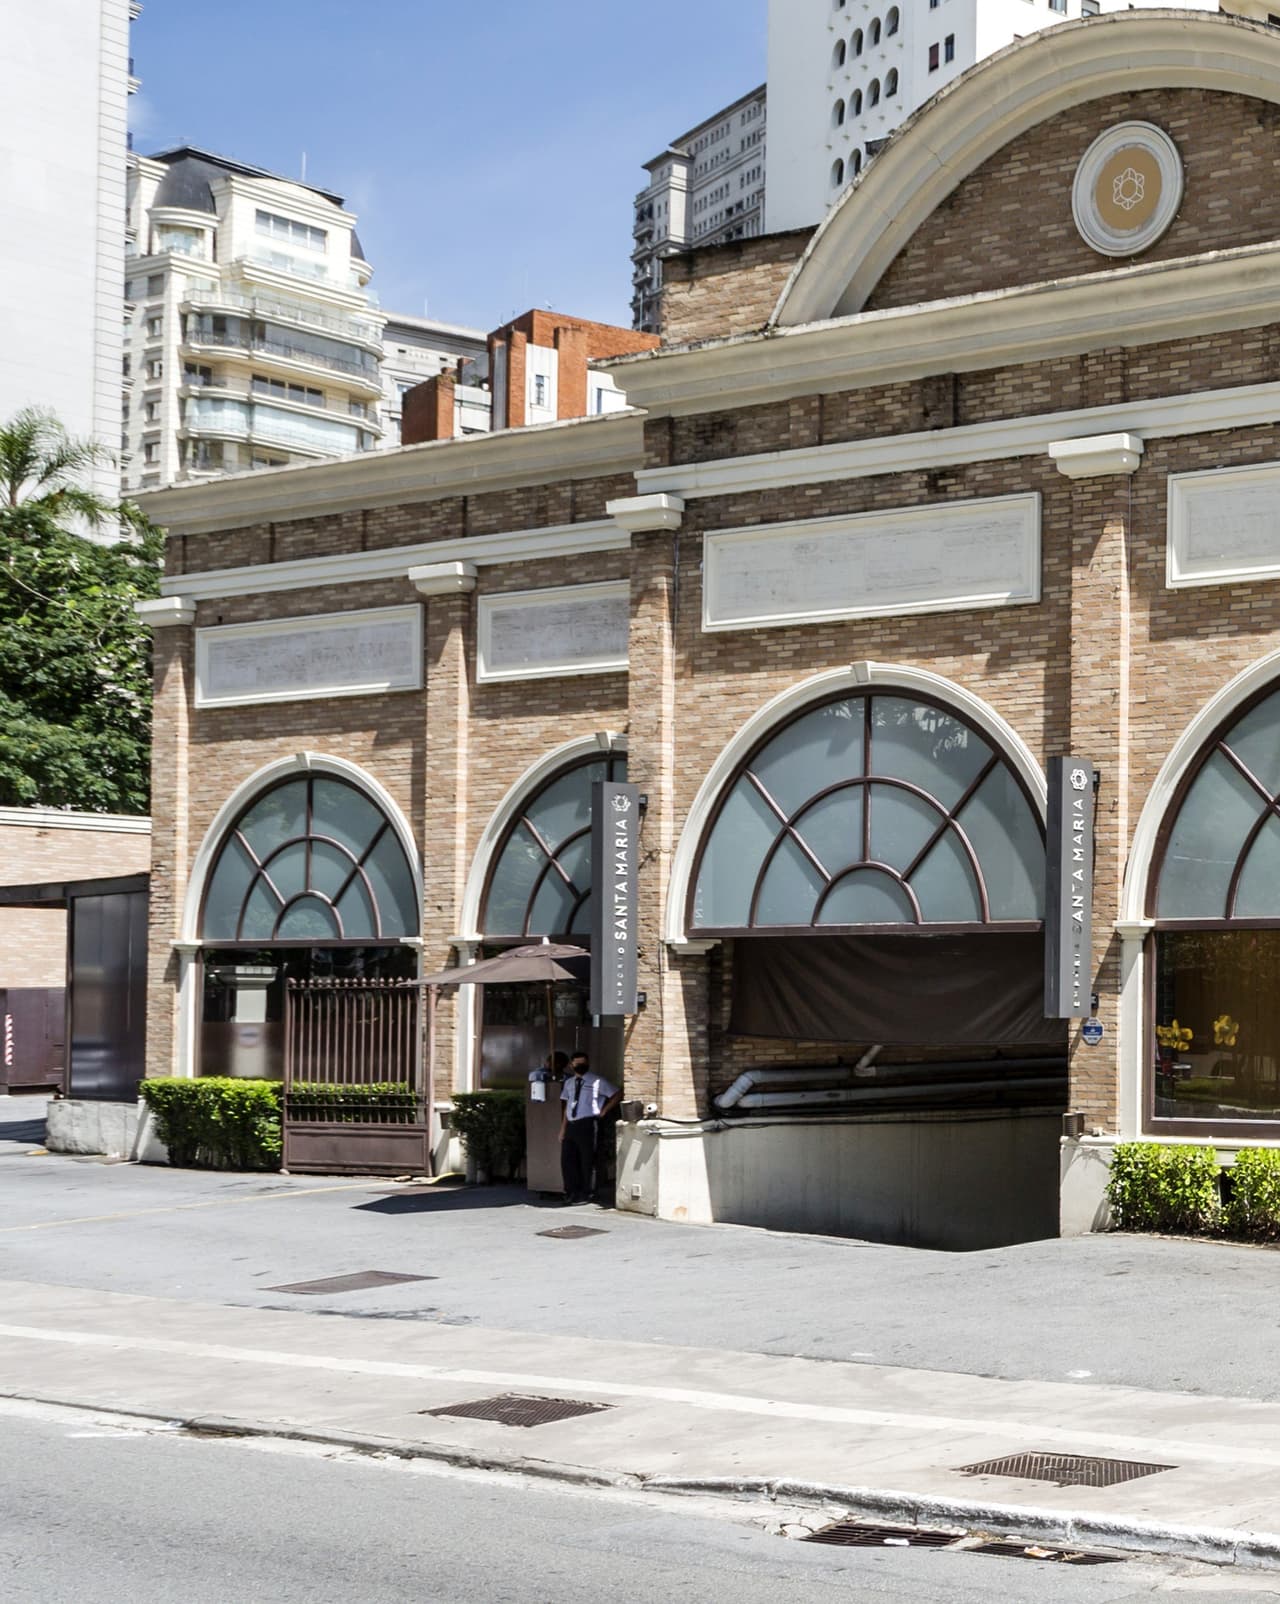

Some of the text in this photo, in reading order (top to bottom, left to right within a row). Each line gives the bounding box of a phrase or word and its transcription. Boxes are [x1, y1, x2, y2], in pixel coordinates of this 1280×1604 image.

[614, 819, 628, 877] MARIA
[1072, 799, 1084, 861] MARIA
[614, 882, 628, 940] SANTA
